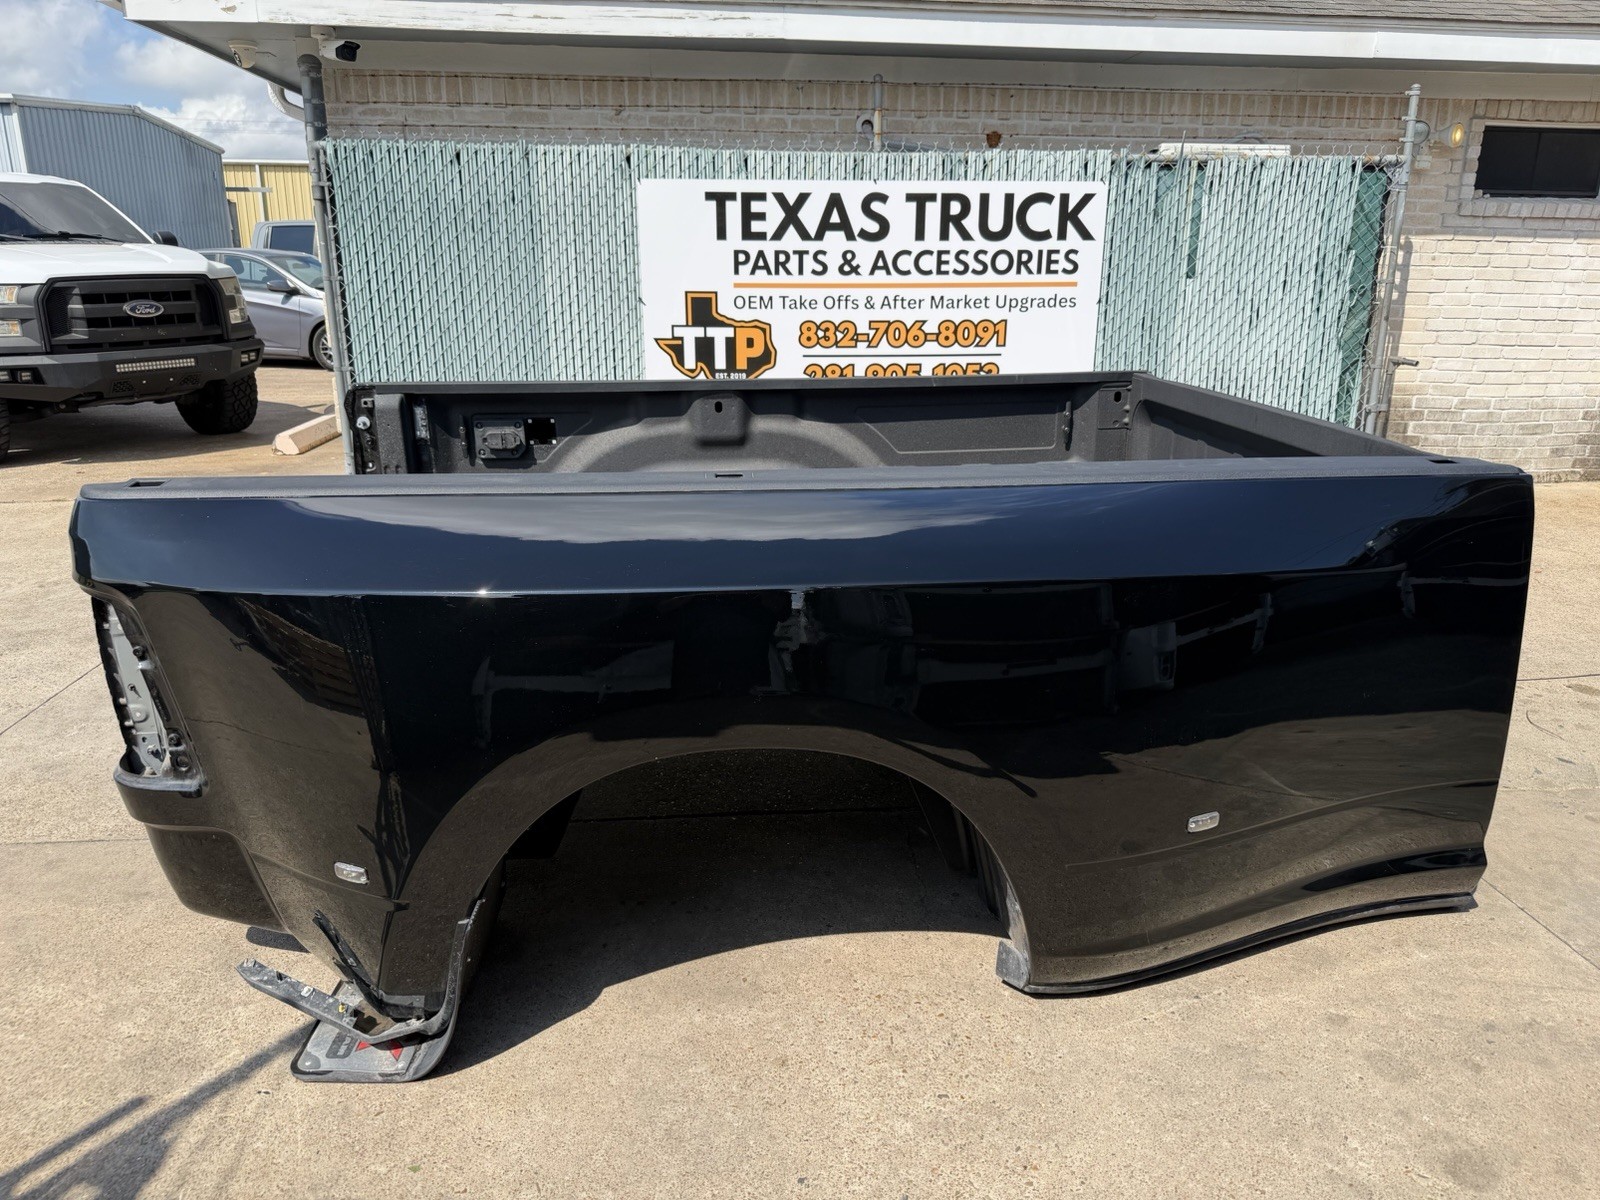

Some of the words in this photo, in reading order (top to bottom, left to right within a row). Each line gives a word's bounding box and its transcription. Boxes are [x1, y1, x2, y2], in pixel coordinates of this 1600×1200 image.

[704, 191, 891, 242] TEXAS
[905, 191, 1097, 242] TRUCK
[733, 249, 829, 276] PARTS
[837, 249, 863, 276] &
[868, 248, 1080, 276] ACCESSORIES
[135, 304, 156, 314] Ford
[733, 295, 774, 310] OEM
[779, 295, 818, 310] Take
[823, 294, 860, 310] Offs
[864, 295, 876, 310] &
[880, 294, 925, 310] After
[930, 294, 991, 309] Market
[995, 293, 1077, 313] Upgrades
[798, 319, 1008, 348] 832-706-8091
[671, 325, 766, 371] TTP
[730, 372, 747, 380] 2019
